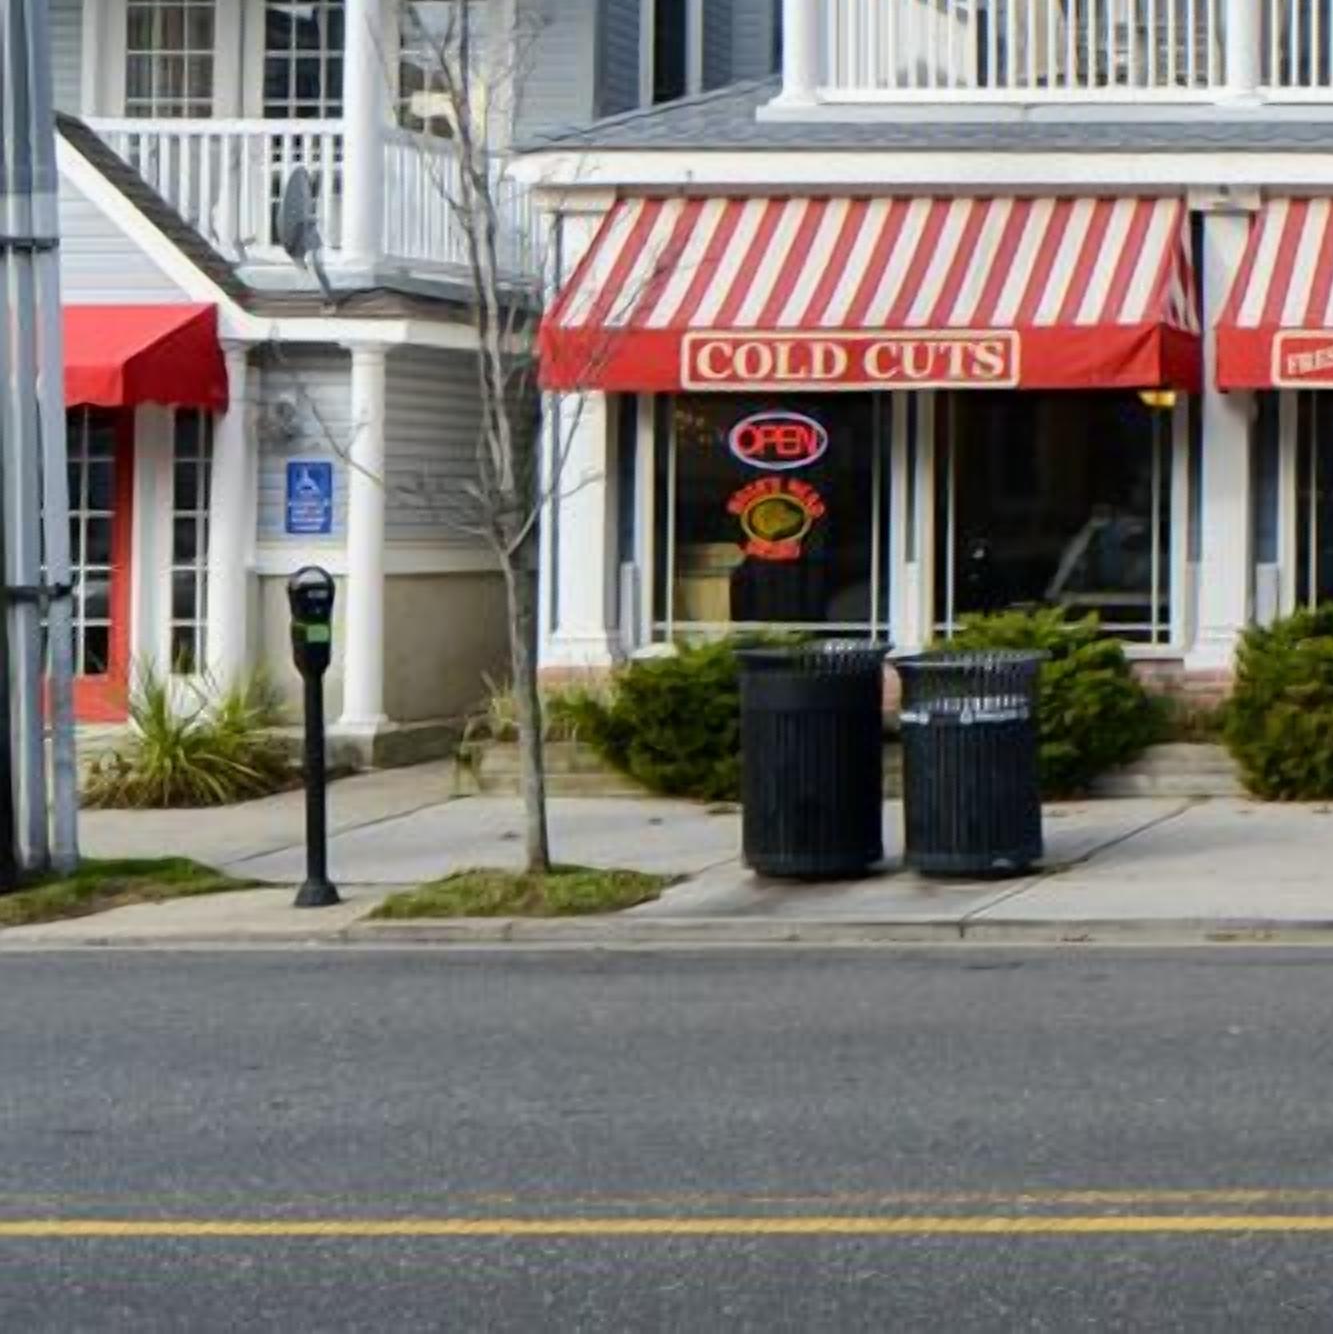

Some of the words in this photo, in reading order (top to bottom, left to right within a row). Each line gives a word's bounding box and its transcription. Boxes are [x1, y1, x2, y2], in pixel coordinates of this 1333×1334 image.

[696, 340, 848, 380] COLD
[863, 340, 1005, 380] CUTS
[737, 423, 817, 457] OPEN
